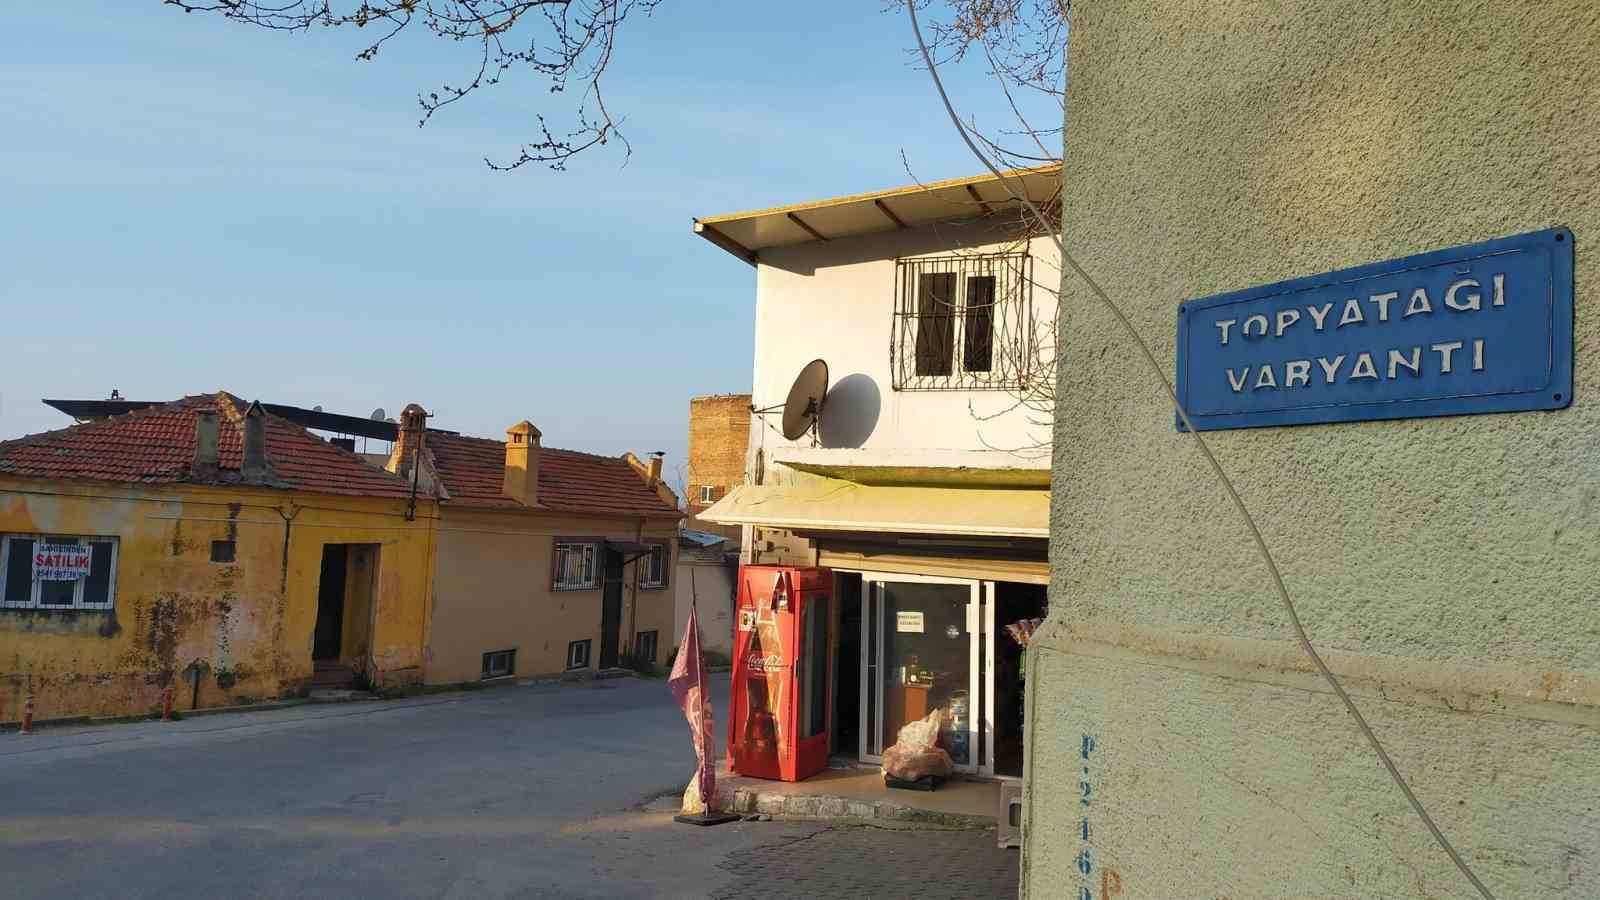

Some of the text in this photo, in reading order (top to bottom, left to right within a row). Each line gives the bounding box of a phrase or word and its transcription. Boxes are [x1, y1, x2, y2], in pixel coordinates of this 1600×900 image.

[1215, 268, 1506, 345] TOPYATAĞI
[1225, 338, 1486, 392] VARYANTI
[36, 553, 89, 568] SATILIK
